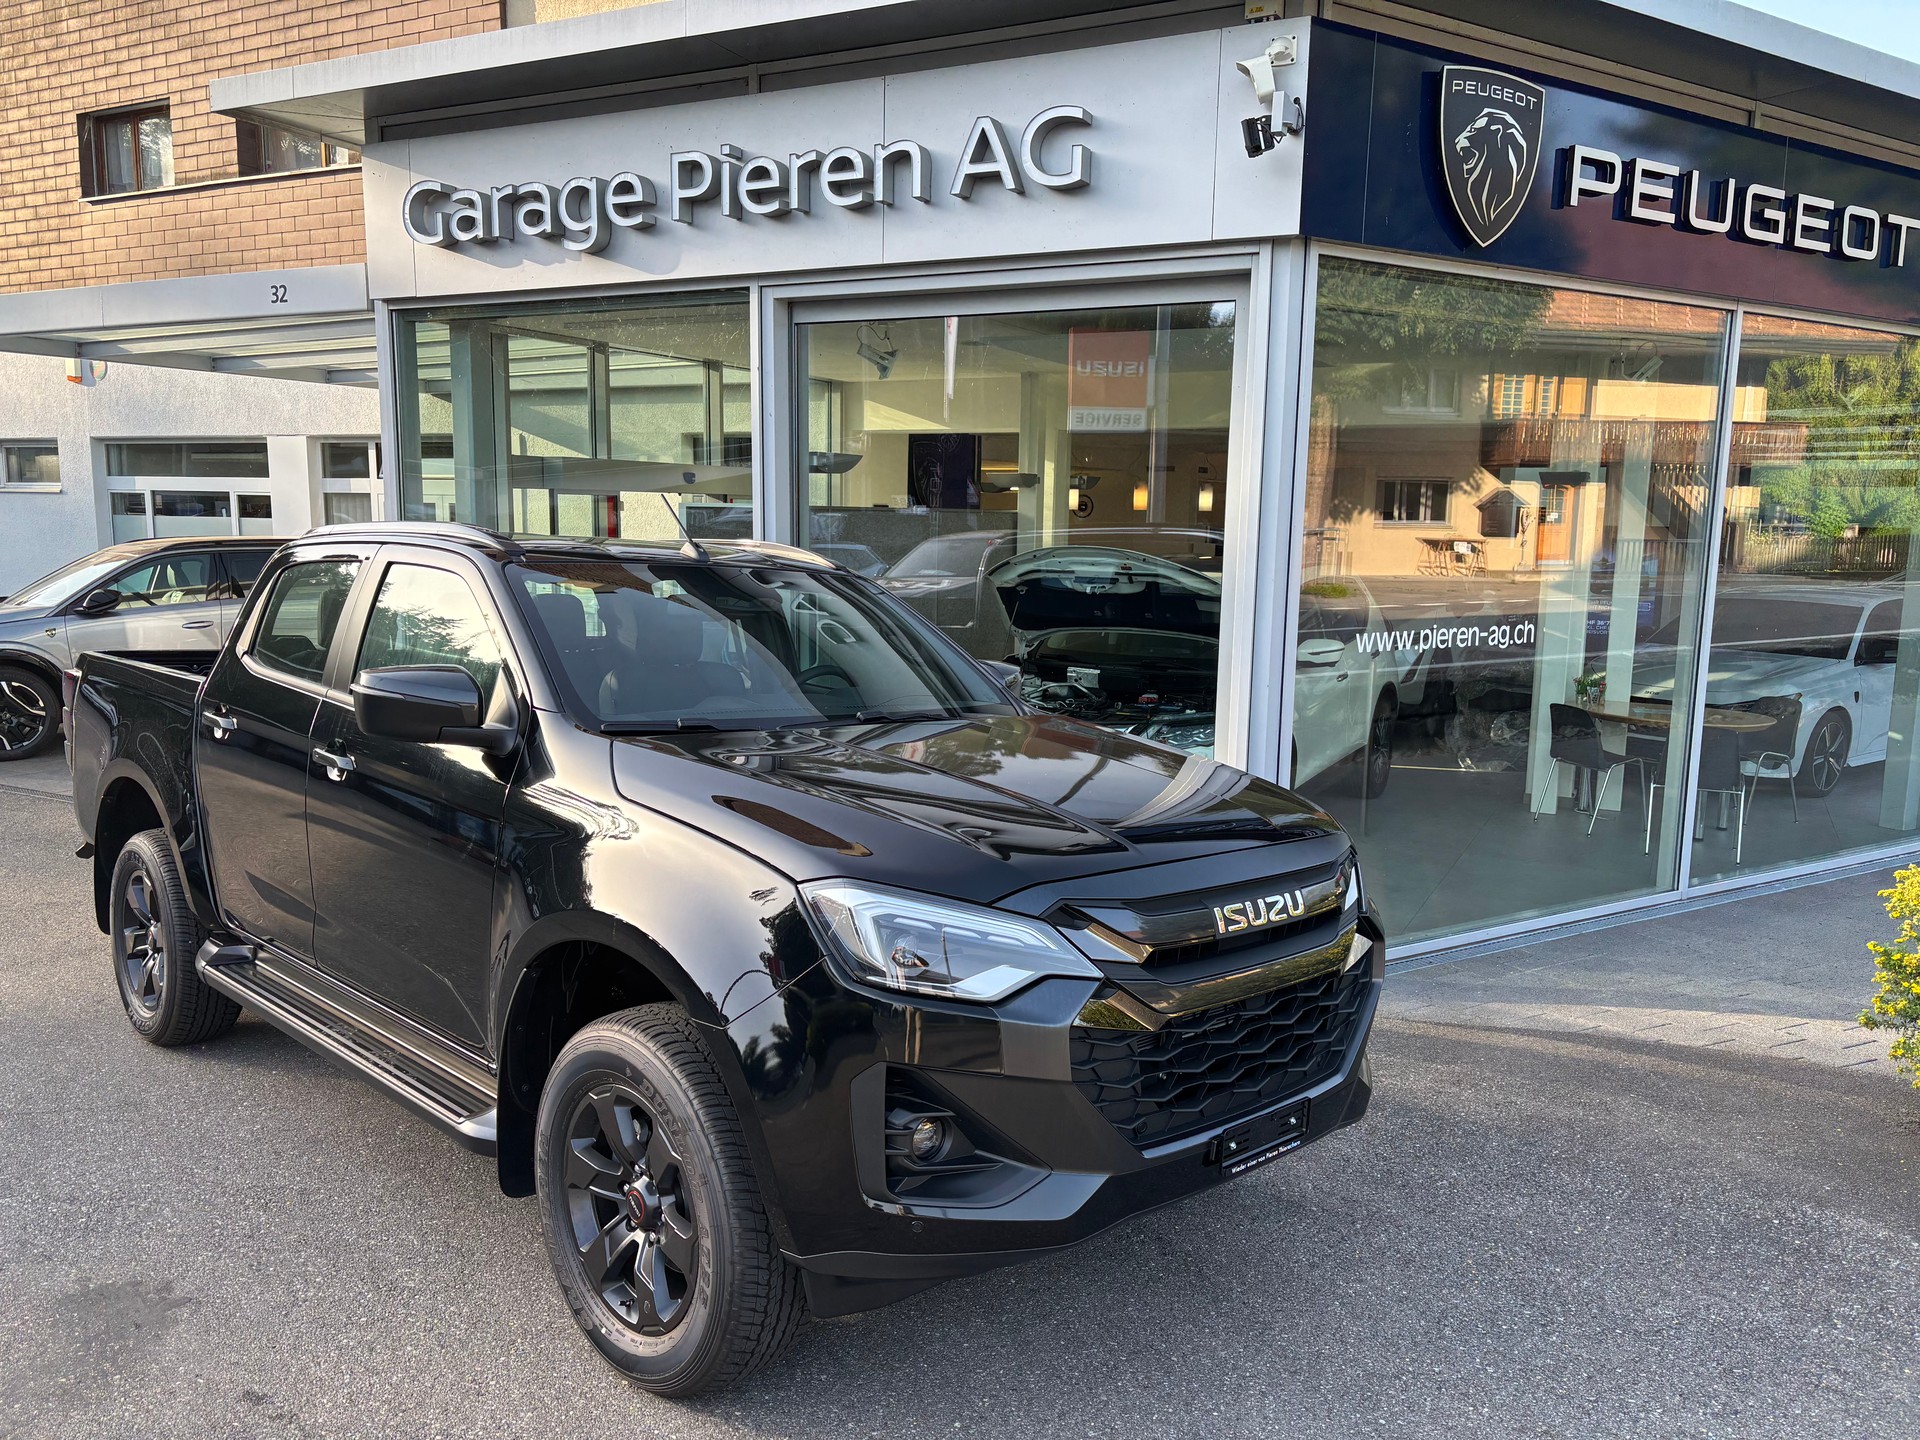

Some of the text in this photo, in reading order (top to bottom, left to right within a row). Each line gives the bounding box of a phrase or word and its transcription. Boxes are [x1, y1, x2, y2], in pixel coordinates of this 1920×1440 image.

[1452, 80, 1538, 110] PEUGEOT
[402, 104, 1093, 253] Garage Pieren AG
[1568, 144, 1920, 267] PEUGEOT
[270, 284, 288, 304] 32
[1355, 620, 1535, 654] www.pieren-ag.ch
[1213, 889, 1305, 934] ISUZU
